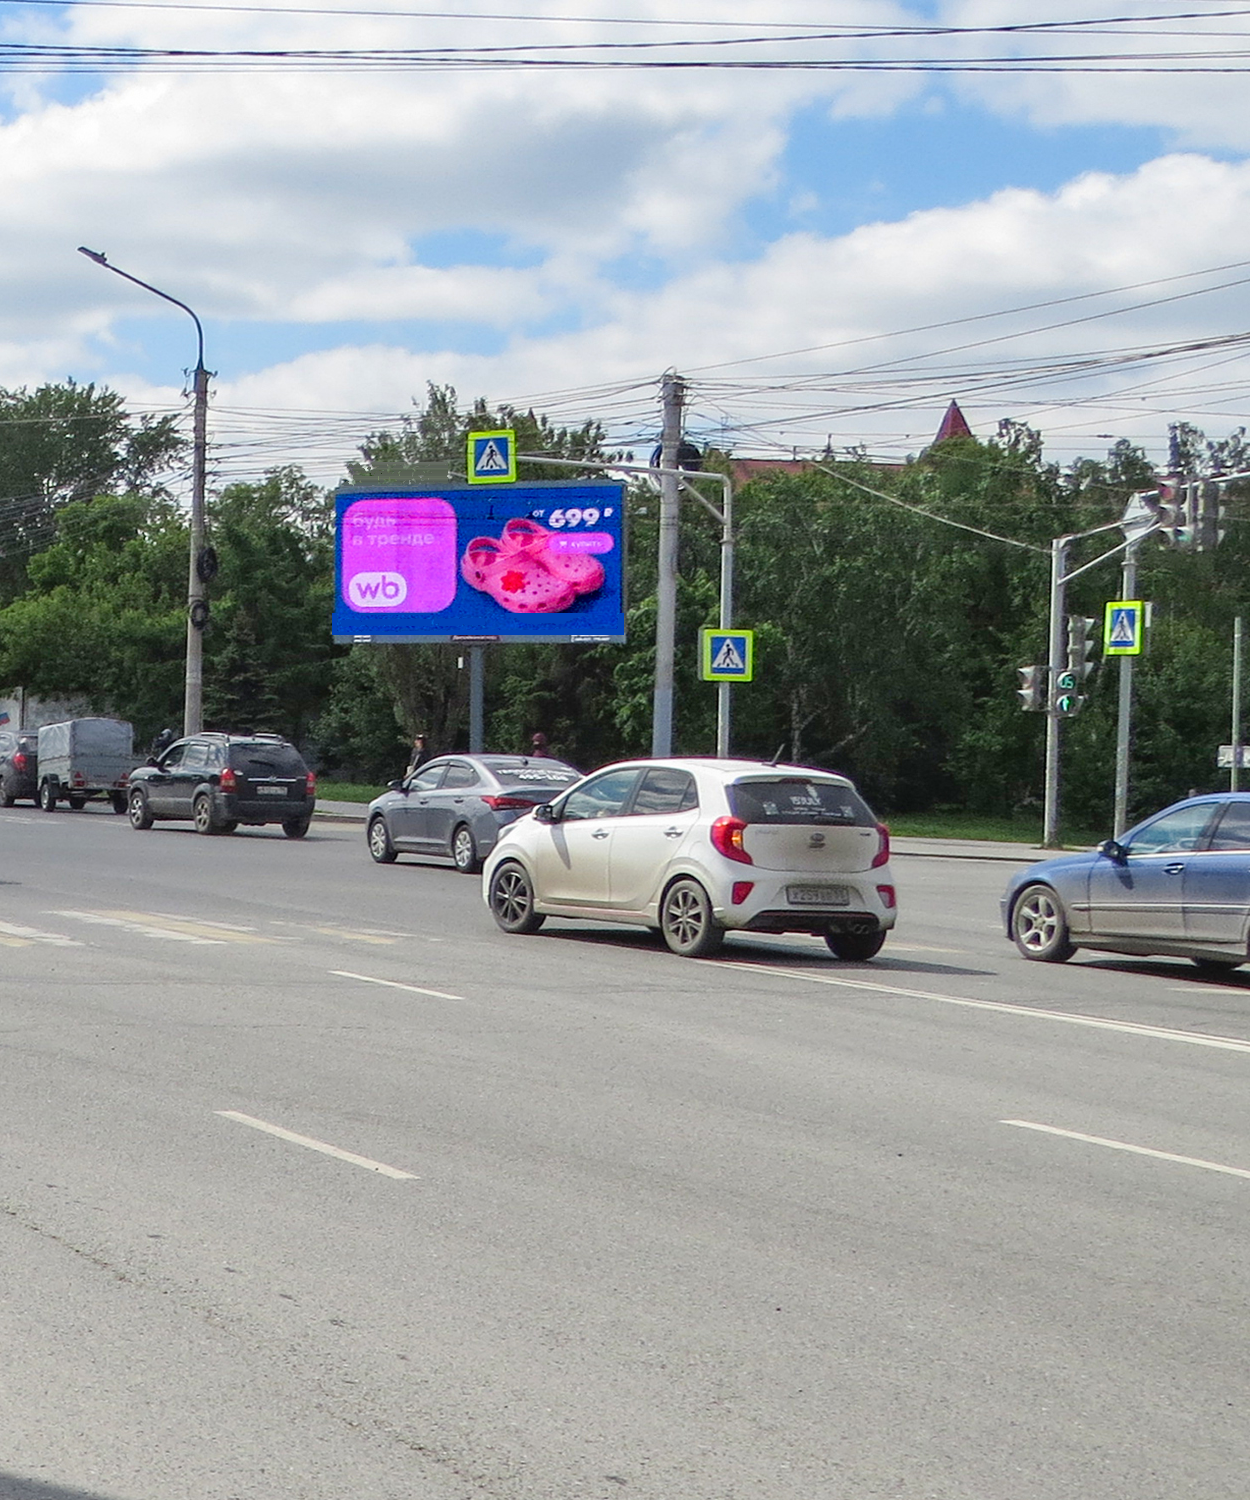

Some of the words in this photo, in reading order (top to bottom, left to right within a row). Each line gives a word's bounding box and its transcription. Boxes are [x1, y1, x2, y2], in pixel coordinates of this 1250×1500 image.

[352, 511, 397, 530] будь
[548, 507, 601, 529] 699
[366, 532, 436, 548] тренде
[355, 574, 401, 600] wb
